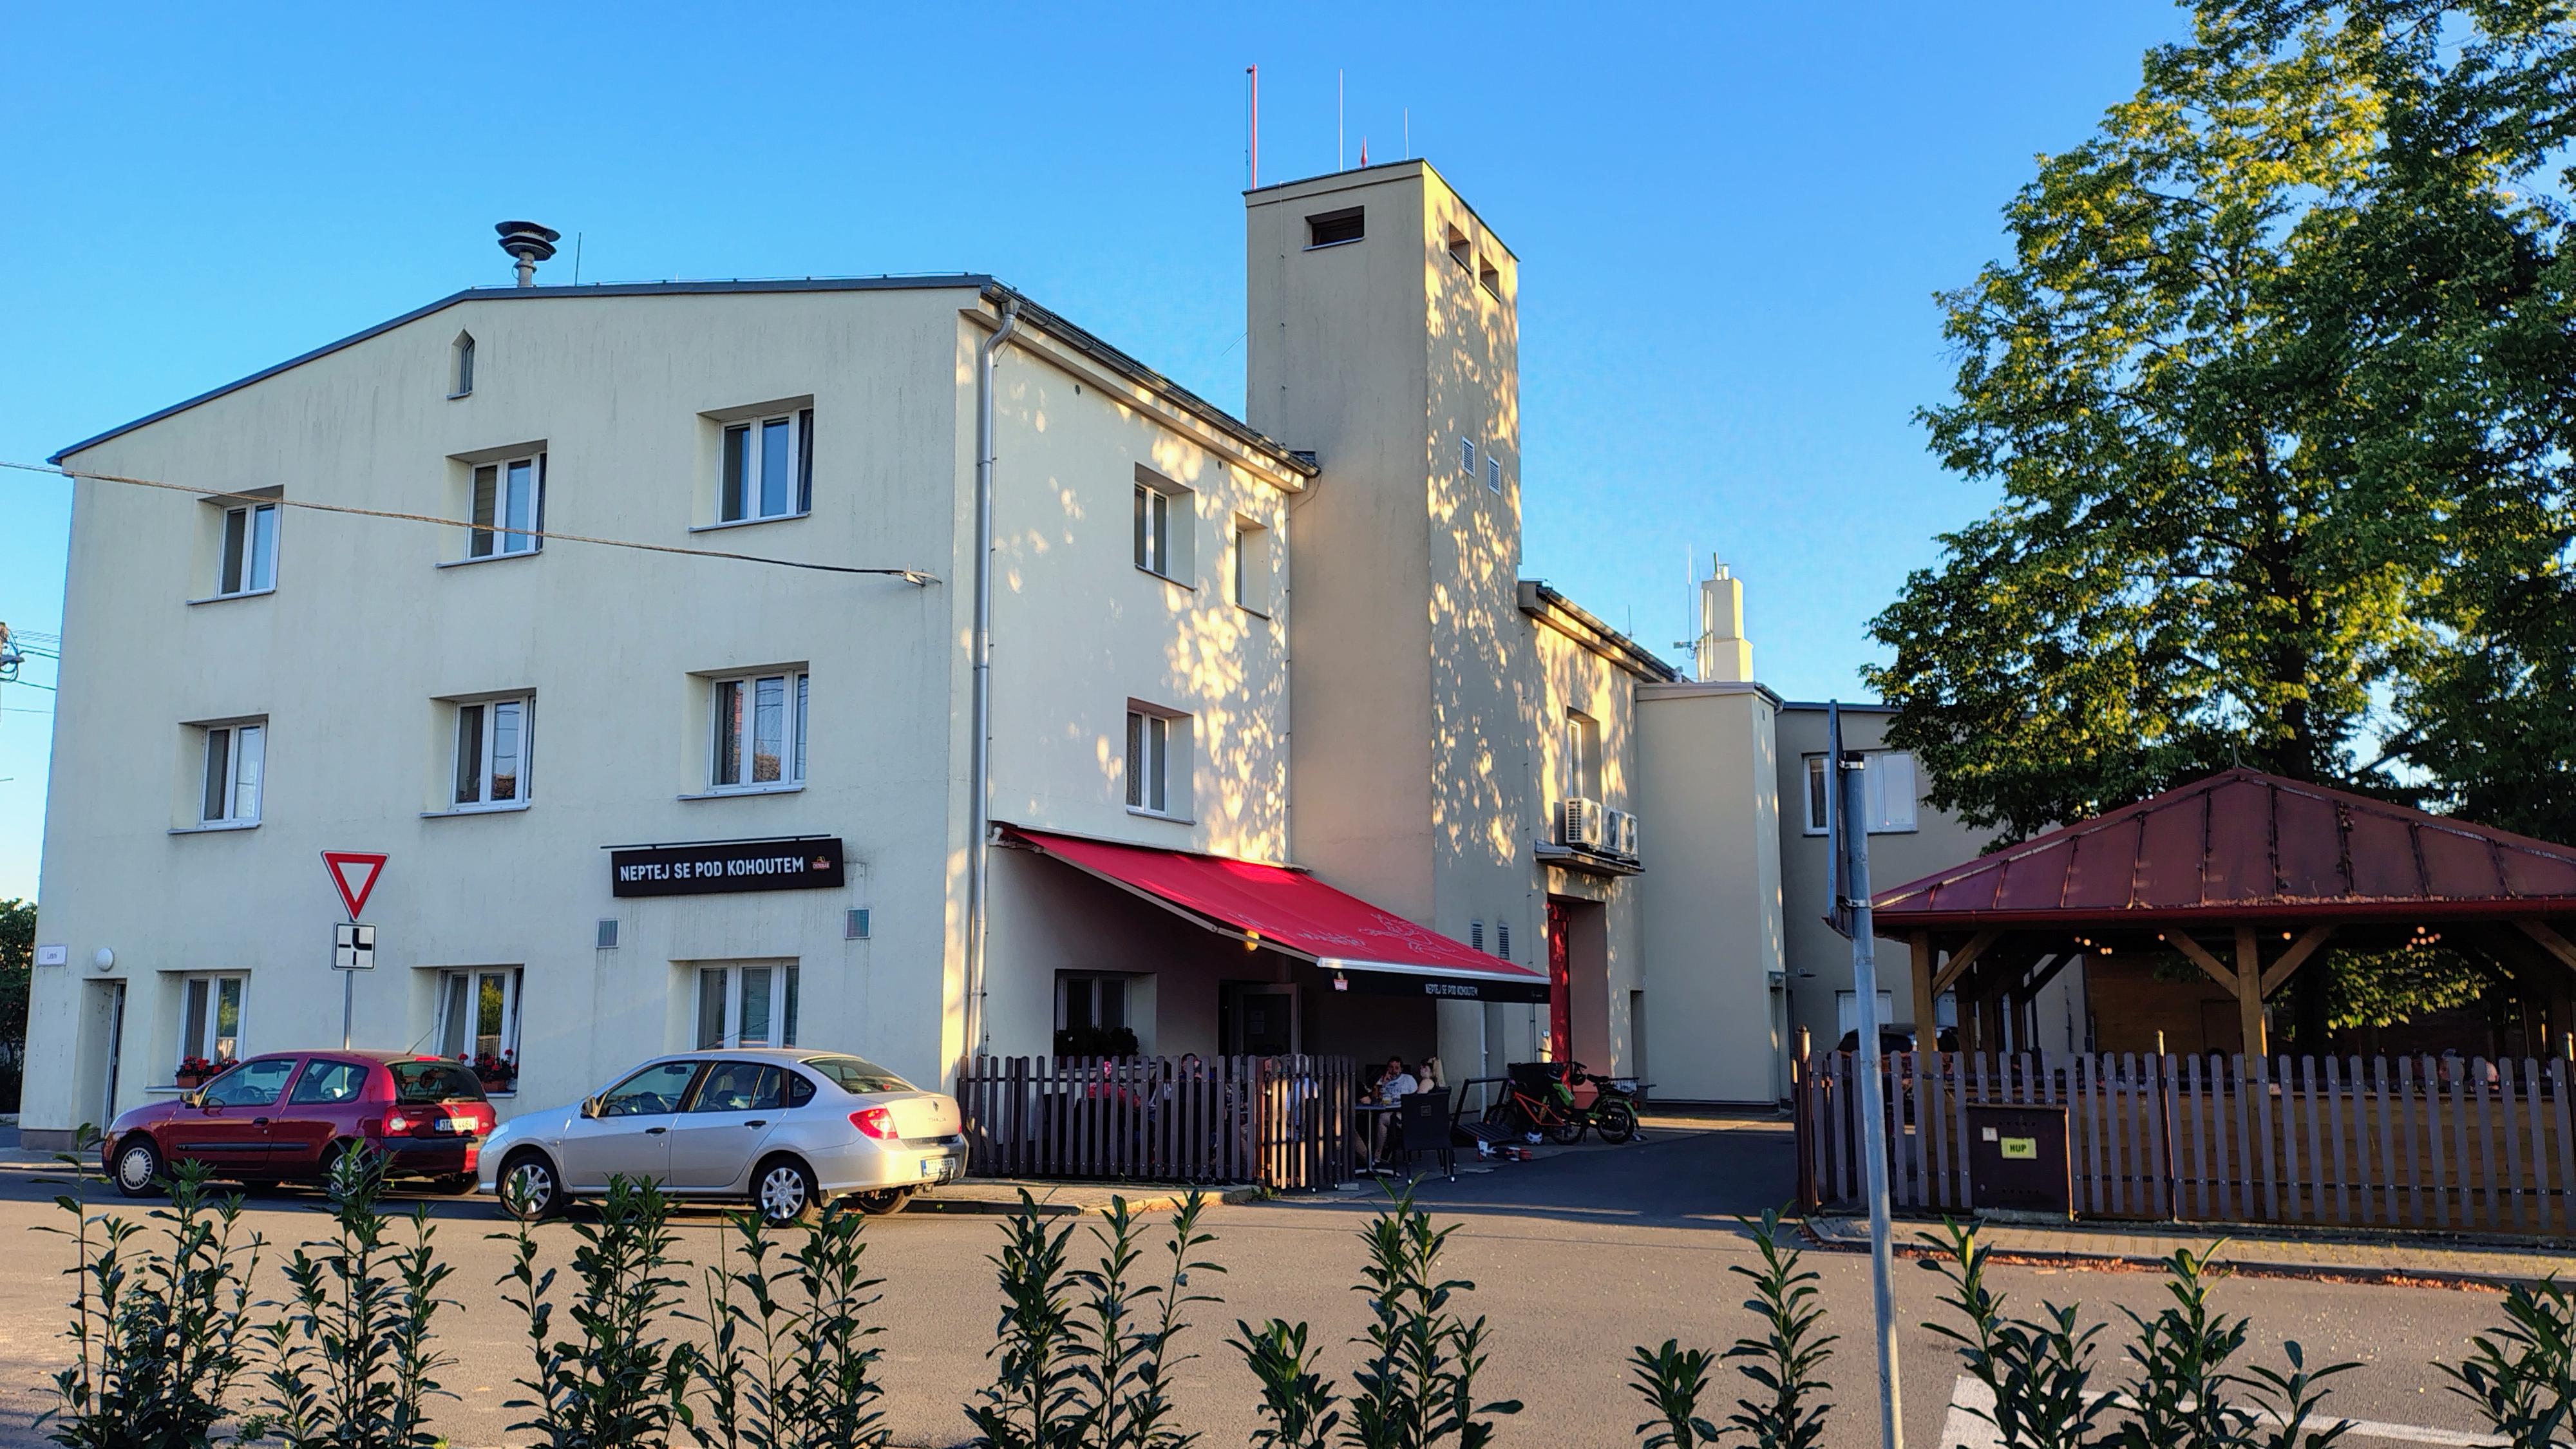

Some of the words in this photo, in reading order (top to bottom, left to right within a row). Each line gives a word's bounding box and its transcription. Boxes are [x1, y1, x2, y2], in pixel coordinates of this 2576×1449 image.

[620, 864, 670, 882] NEPTEJ
[674, 862, 691, 879] SE
[696, 860, 723, 878] POD
[727, 857, 804, 876] KOHOUTEM
